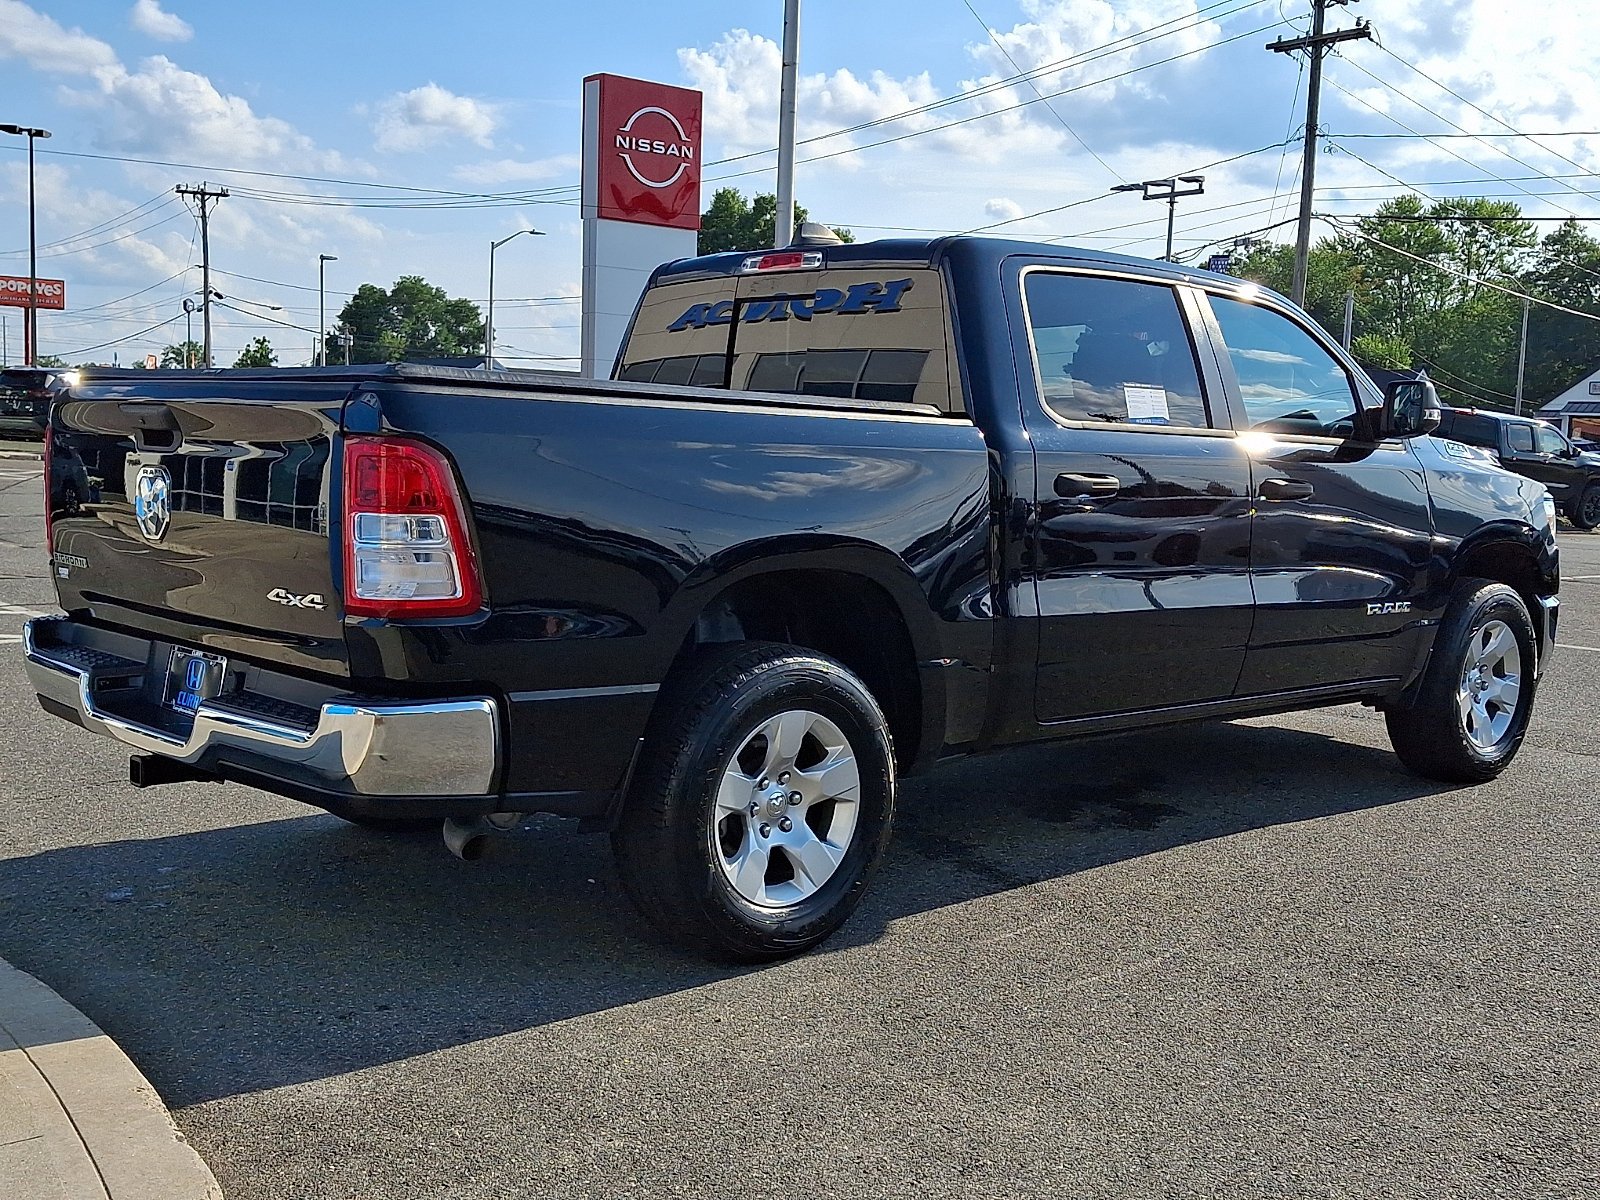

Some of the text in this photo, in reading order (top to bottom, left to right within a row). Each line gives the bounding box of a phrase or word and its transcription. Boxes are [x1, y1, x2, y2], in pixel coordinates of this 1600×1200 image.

[616, 135, 693, 159] NISSAN
[266, 588, 328, 611] 4x4
[1366, 602, 1411, 615] RAM
